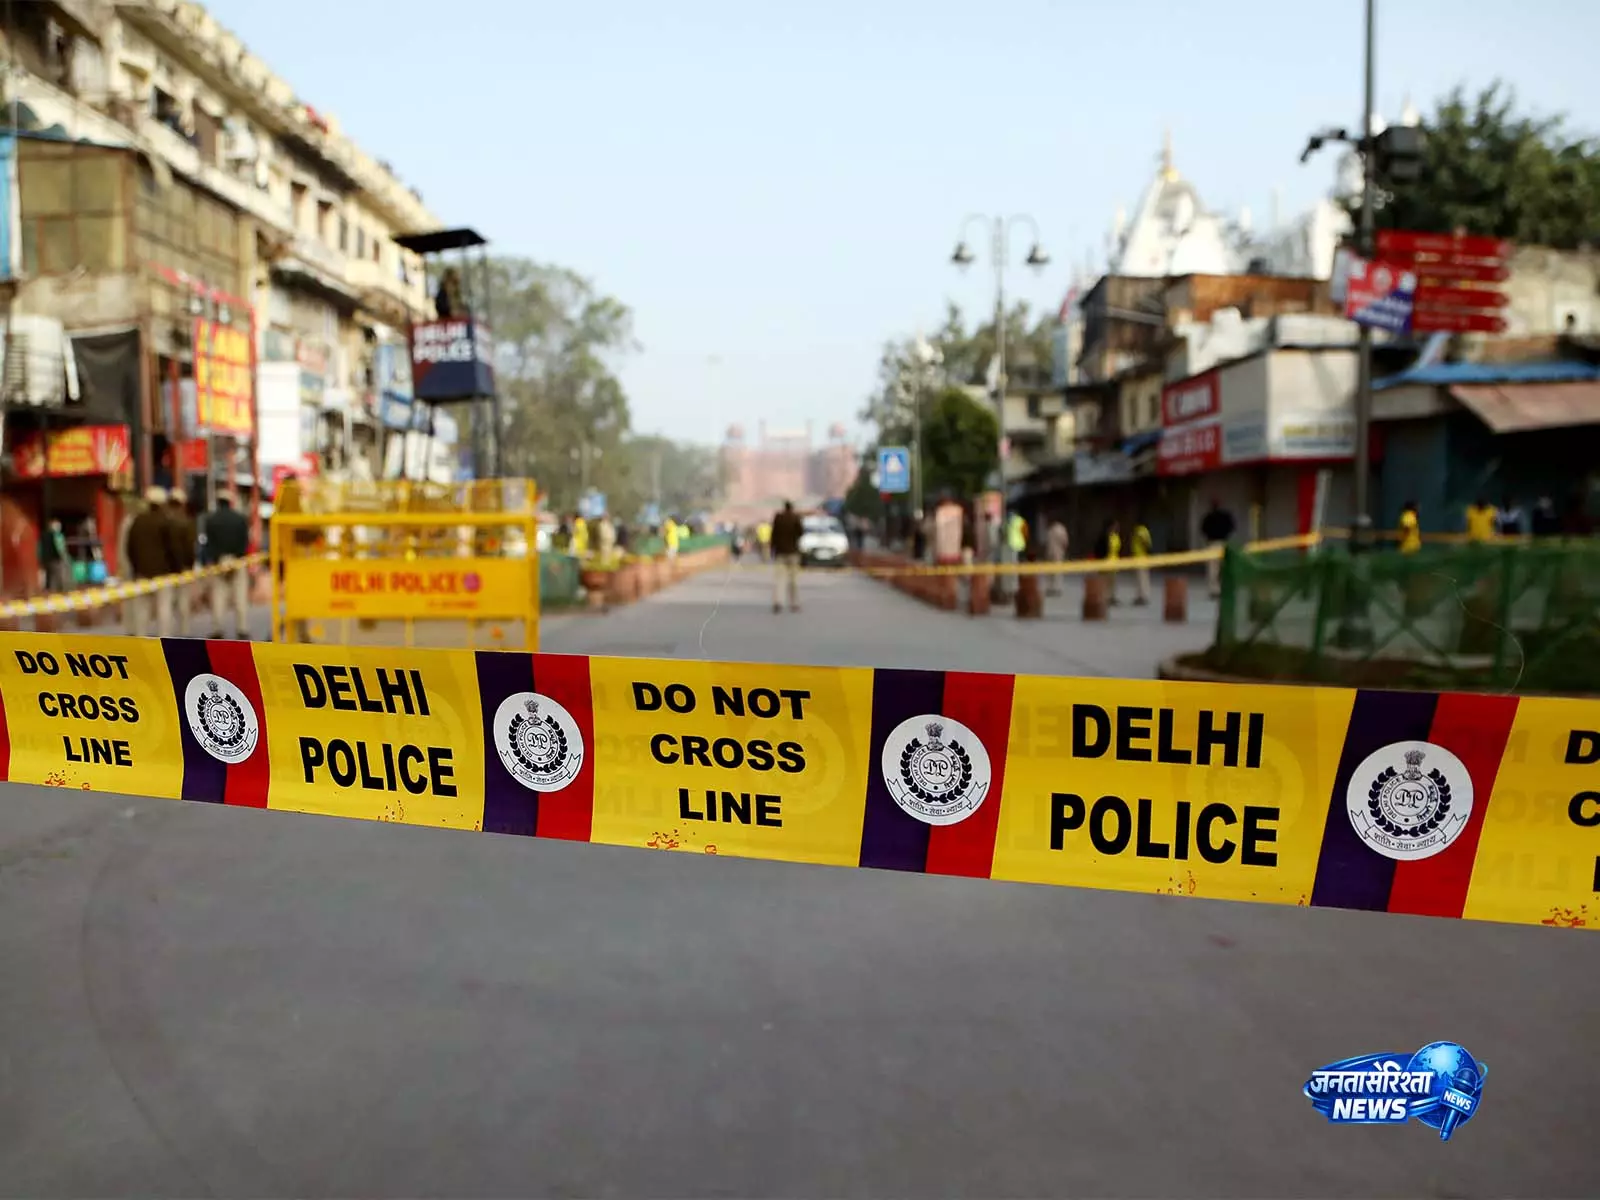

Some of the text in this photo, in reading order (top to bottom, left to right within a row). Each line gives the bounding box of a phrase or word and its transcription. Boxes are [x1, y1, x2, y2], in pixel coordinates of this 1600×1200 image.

[14, 650, 129, 680] DO NOT
[38, 691, 140, 723] CROSS
[292, 663, 430, 716] DELHI
[632, 682, 811, 720] DO NOT
[63, 736, 133, 767] LINE
[650, 733, 806, 773] CROSS
[1072, 703, 1264, 769] DELHI
[299, 736, 458, 797] POLICE
[678, 788, 783, 828] LINE
[1050, 792, 1280, 867] POLICE
